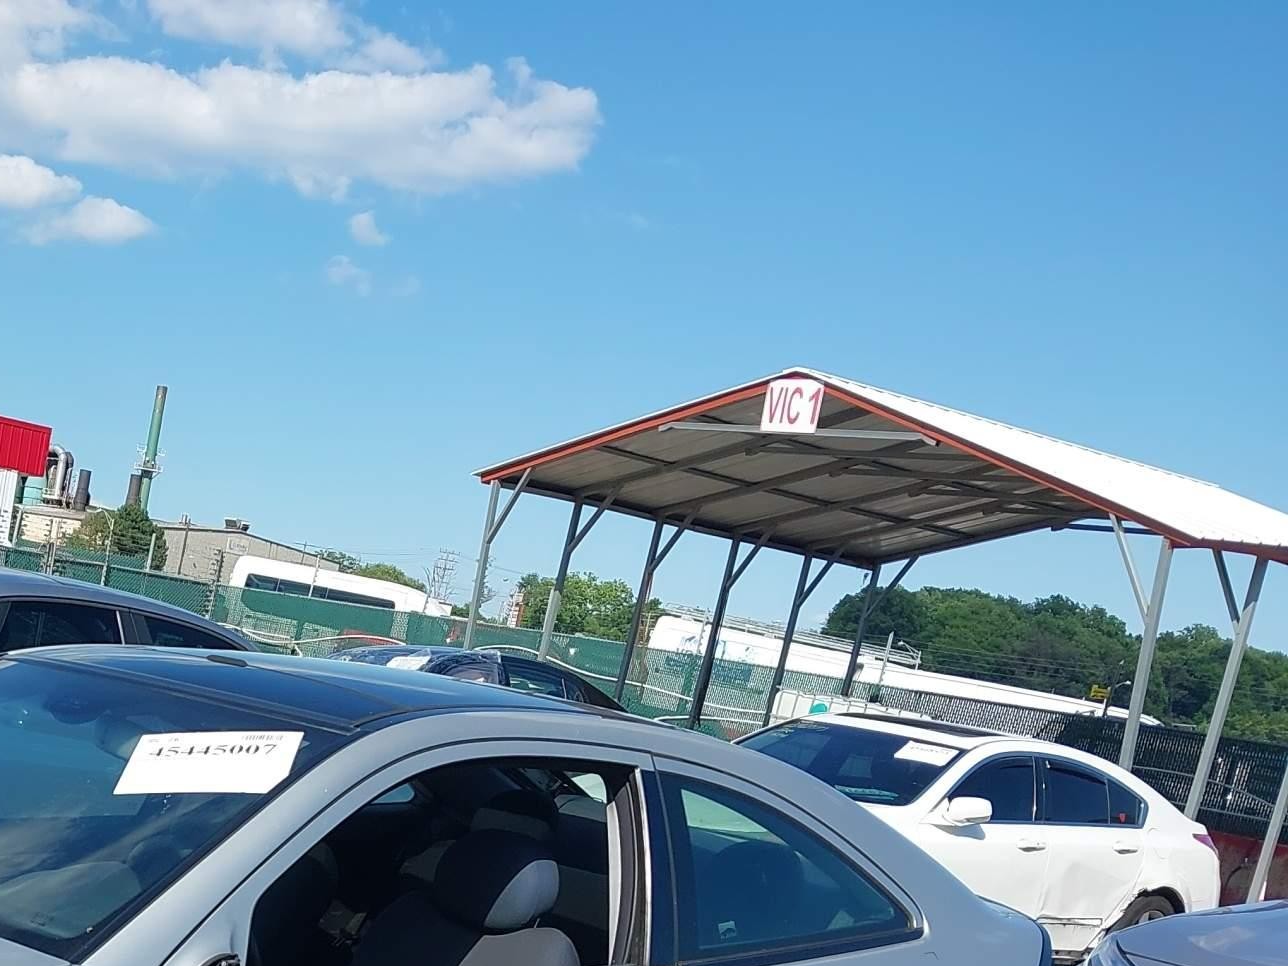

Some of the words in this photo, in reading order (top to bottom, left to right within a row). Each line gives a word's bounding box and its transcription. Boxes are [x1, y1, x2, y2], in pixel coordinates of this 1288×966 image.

[768, 386, 804, 425] VIC
[809, 387, 822, 425] 1
[149, 743, 278, 757] 45445007
